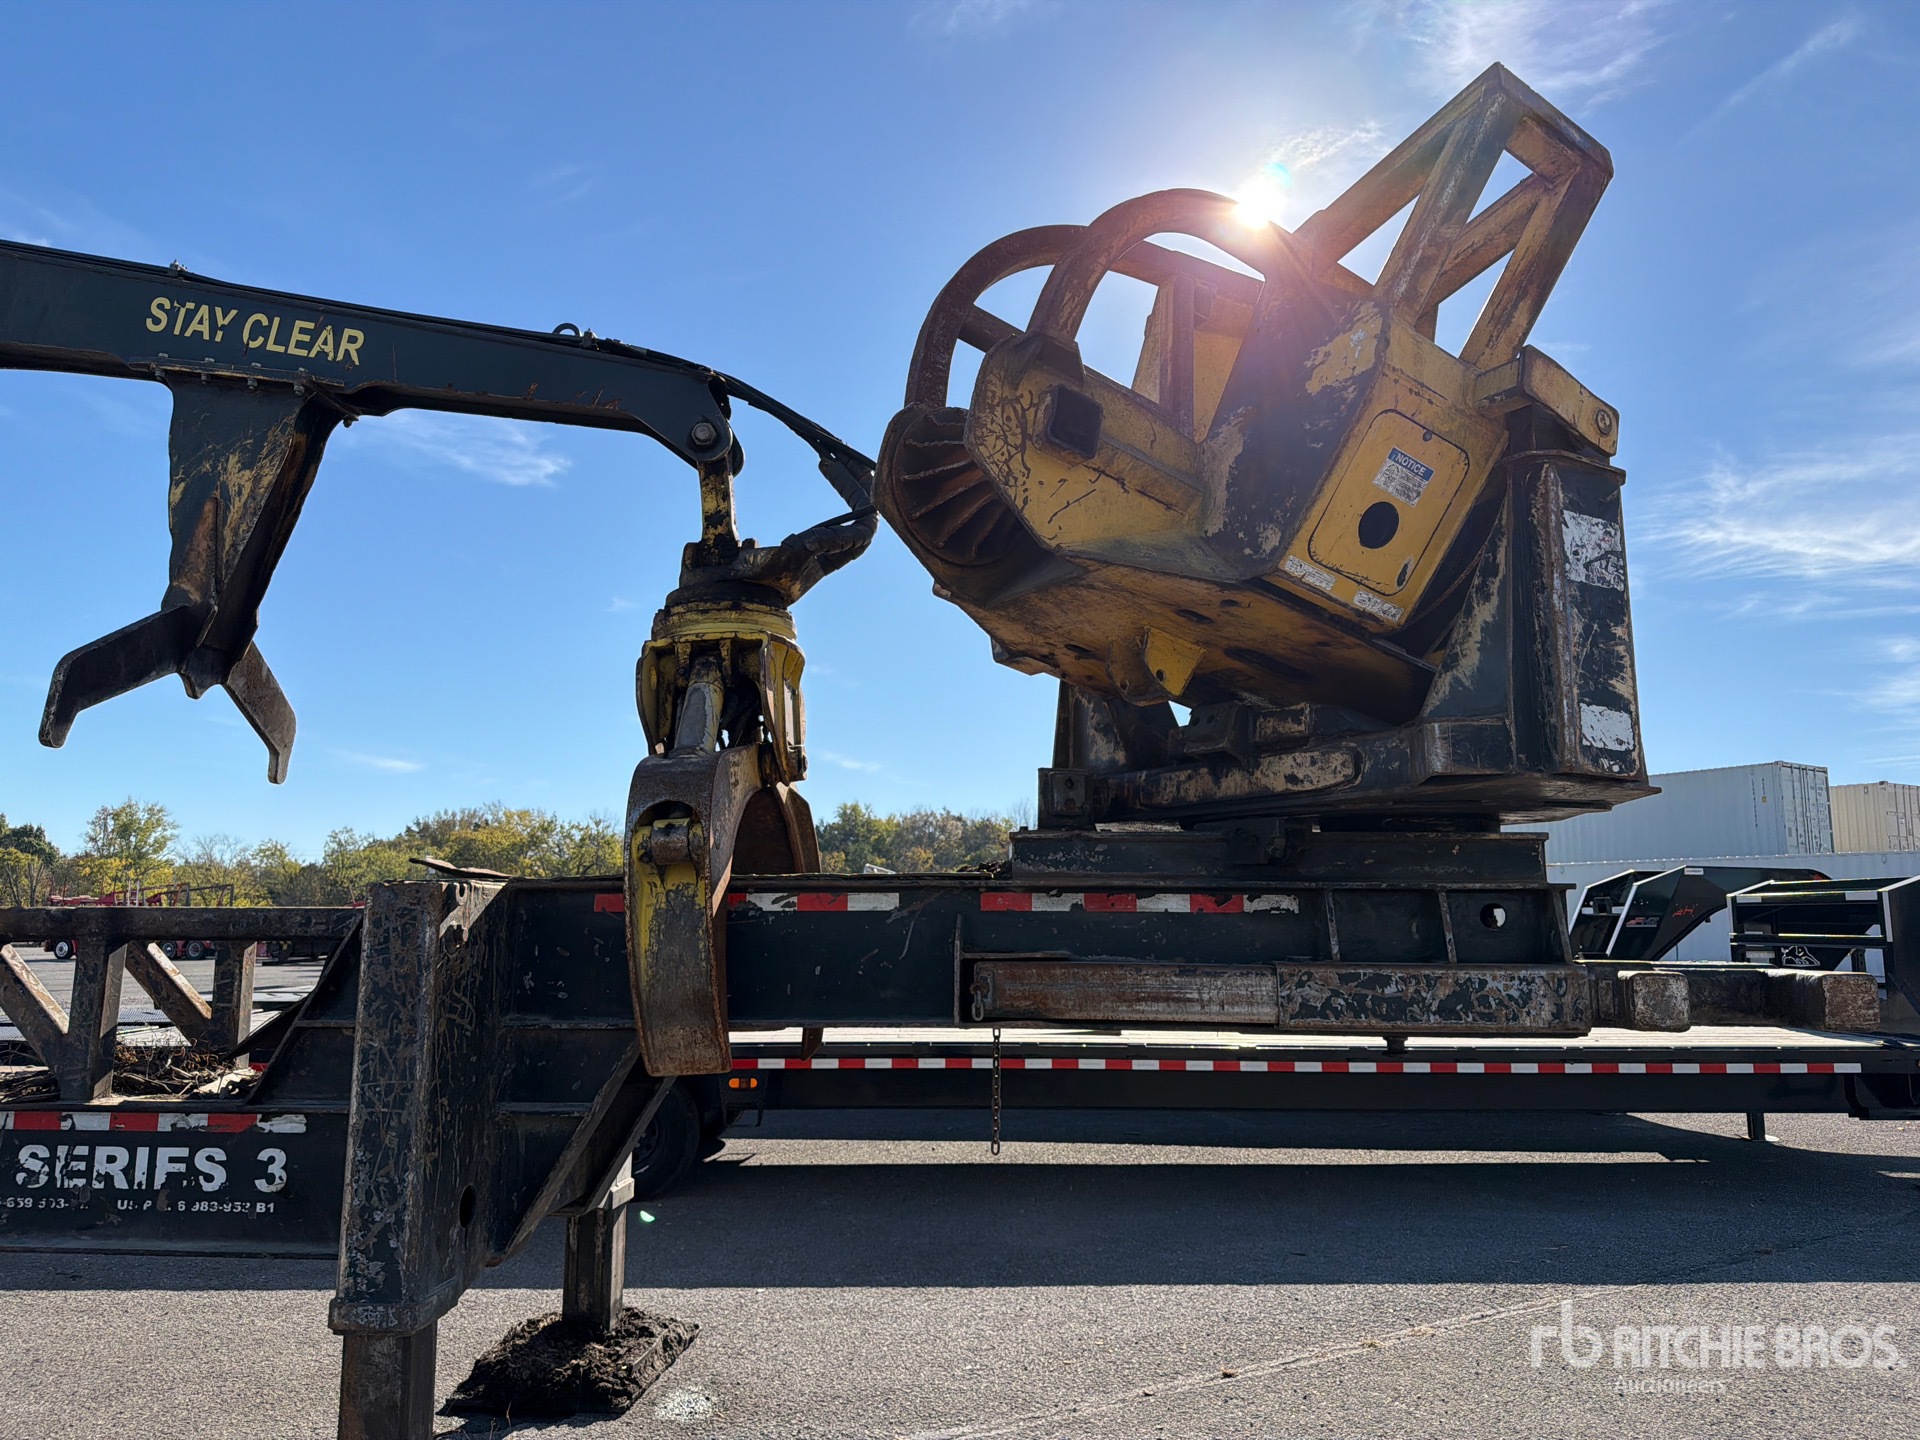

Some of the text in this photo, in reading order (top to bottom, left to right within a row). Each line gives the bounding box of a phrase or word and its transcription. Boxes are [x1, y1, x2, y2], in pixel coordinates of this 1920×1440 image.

[145, 297, 365, 366] STAY CLEAR
[1395, 453, 1427, 476] NOTICE
[254, 1148, 288, 1193] 3
